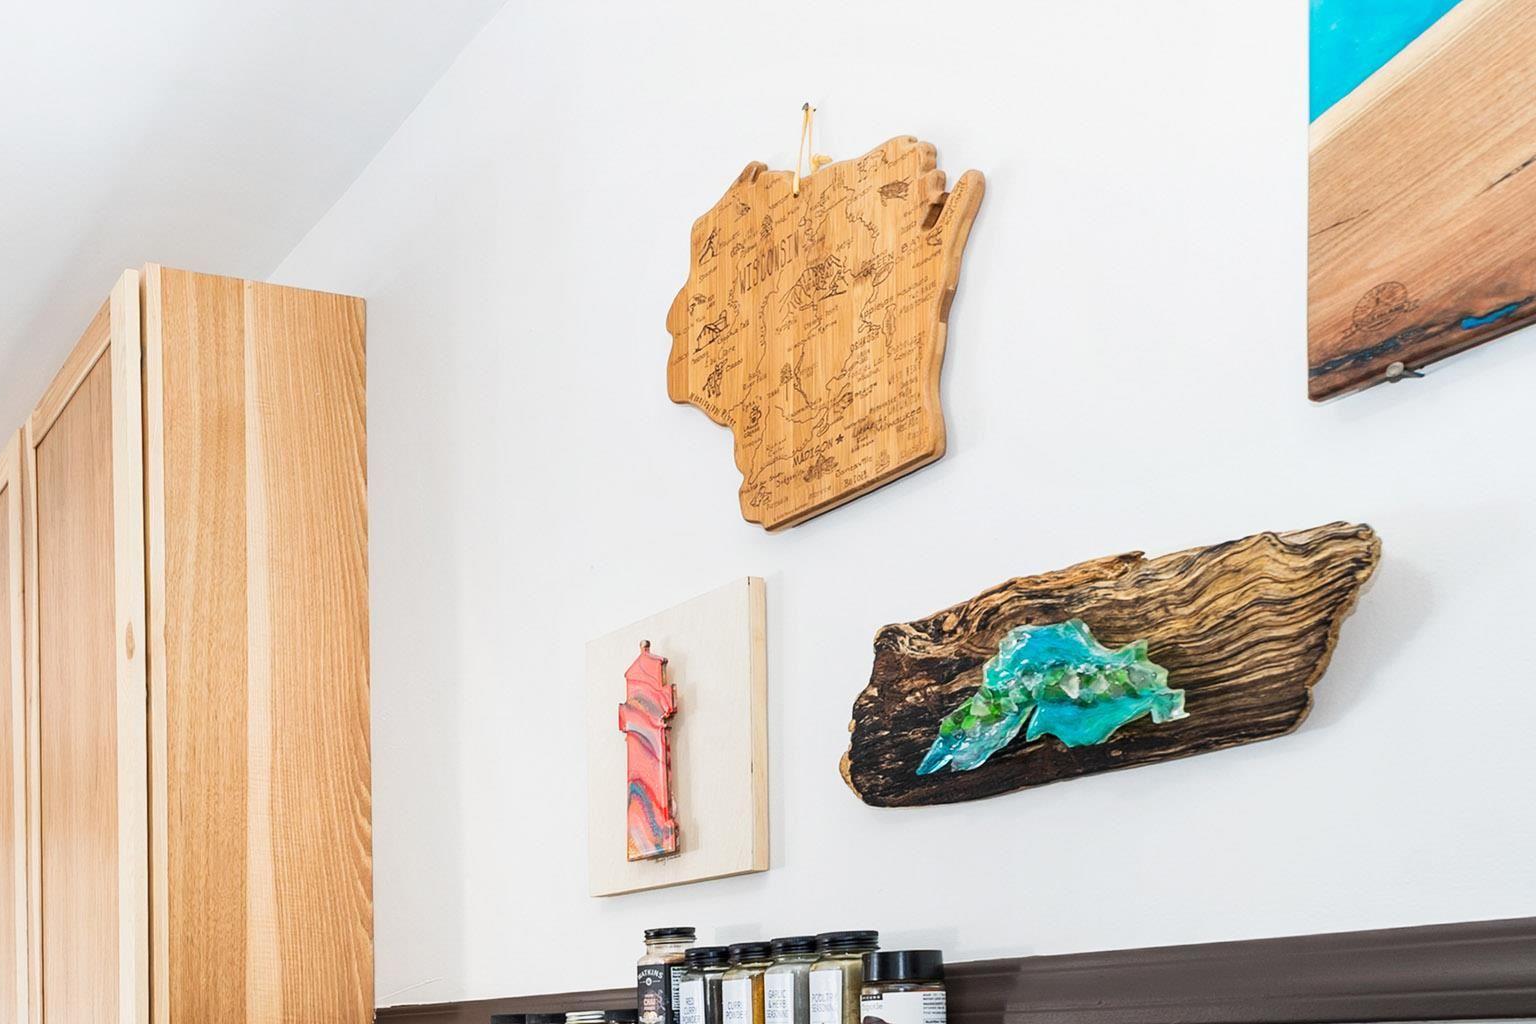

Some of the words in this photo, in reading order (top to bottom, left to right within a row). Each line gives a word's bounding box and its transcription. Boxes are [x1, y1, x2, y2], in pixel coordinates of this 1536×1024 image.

[739, 230, 799, 294] WISCONSIN
[793, 438, 834, 468] MADISON
[638, 969, 664, 979] WATKINS
